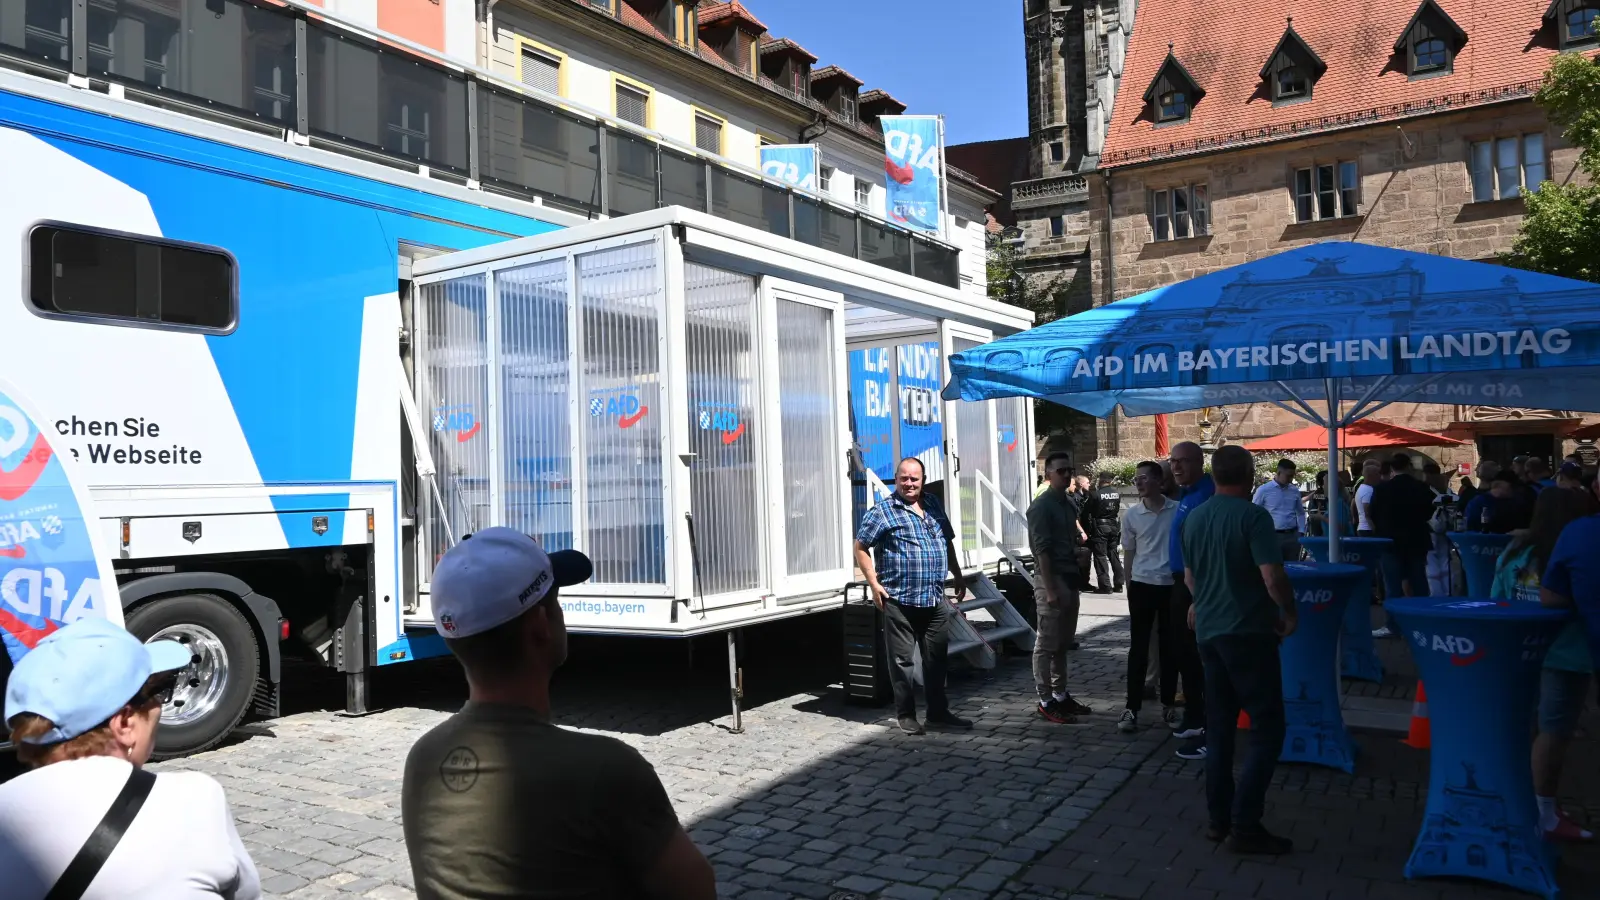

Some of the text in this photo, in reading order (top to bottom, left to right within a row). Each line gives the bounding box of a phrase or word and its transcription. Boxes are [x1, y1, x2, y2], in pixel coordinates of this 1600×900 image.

[1072, 327, 1572, 379] AfD IM BAYERISCHEN LANDTAG
[607, 394, 639, 416] AfD
[54, 415, 118, 437] chen
[123, 417, 160, 438] Sie
[712, 409, 738, 431] AfD
[88, 443, 202, 464] Webseite
[518, 571, 548, 605] PATRIOTS
[1300, 587, 1333, 603] AfD
[561, 601, 645, 615] andtag.bayern
[1432, 634, 1475, 654] AfD
